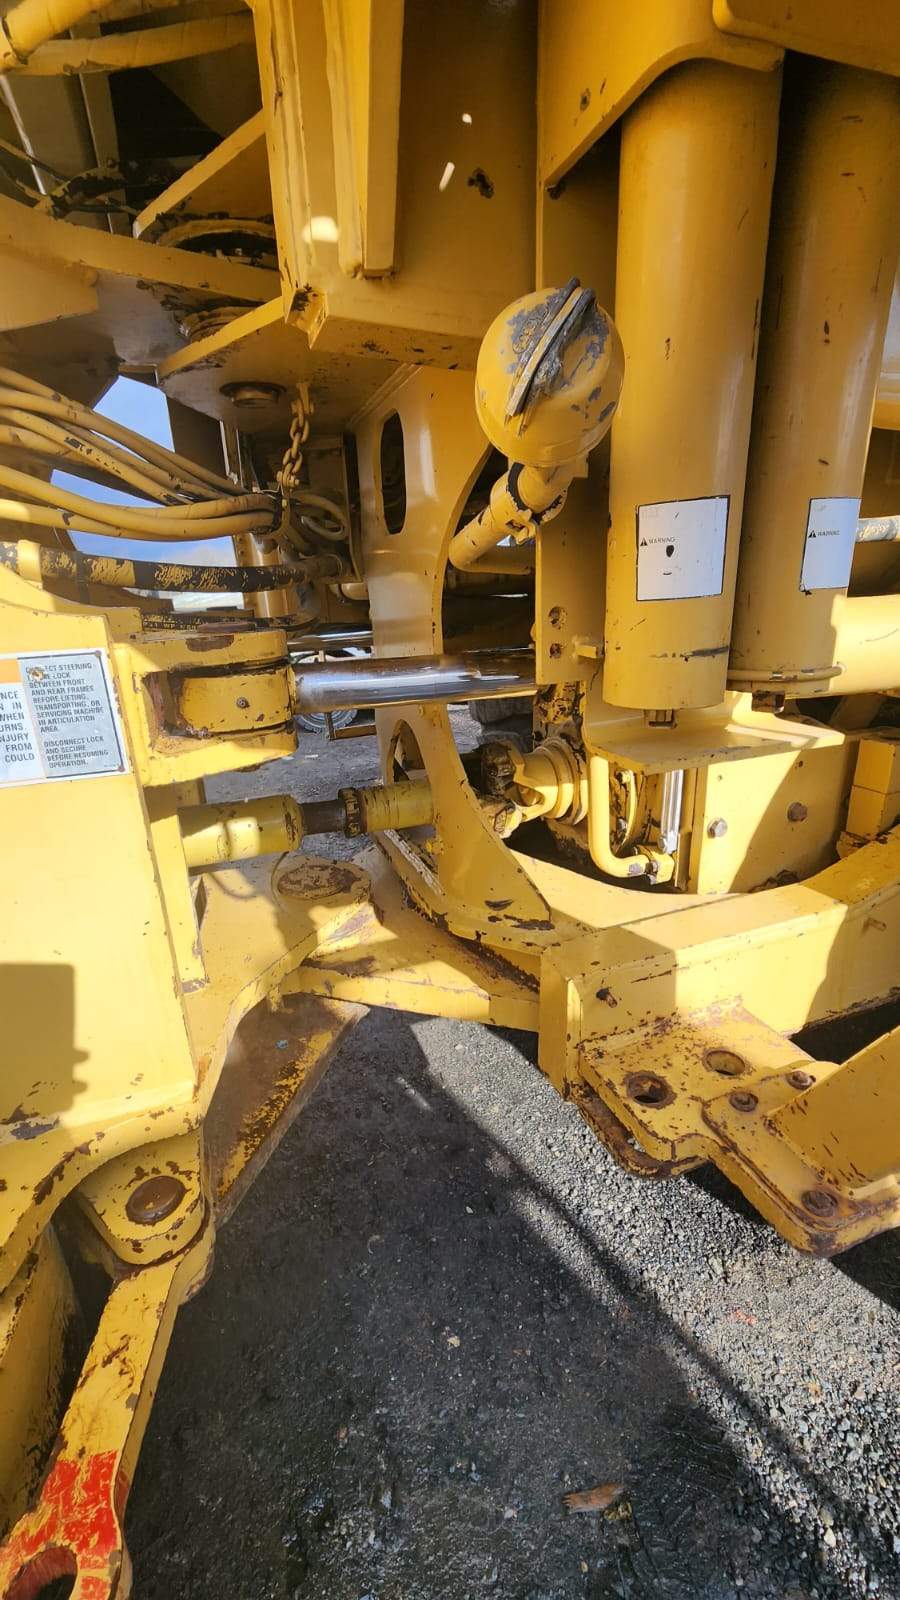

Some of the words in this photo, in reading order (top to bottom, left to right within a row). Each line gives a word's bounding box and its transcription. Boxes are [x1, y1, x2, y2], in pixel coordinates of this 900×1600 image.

[58, 662, 92, 671] STEERING
[52, 672, 71, 680] LOCK
[29, 680, 62, 689] BETWEEN
[63, 679, 86, 687] FRONT
[32, 689, 46, 697] AND
[47, 687, 65, 695] REAR
[67, 685, 95, 694] FRAMES
[33, 695, 60, 704] BEFORE
[91, 699, 101, 707] OR
[36, 708, 72, 718] SERVICING
[72, 706, 105, 715] MACHINE
[38, 718, 46, 726] IN
[47, 715, 95, 725] ARTICULATION
[43, 737, 85, 748] DISCONNECT
[86, 735, 104, 743] LOCK
[5, 742, 33, 753] FROM
[45, 747, 60, 755] AND
[60, 745, 86, 753] SECURE
[5, 752, 35, 763] COULD
[47, 753, 72, 762] BEFORE
[73, 750, 109, 759] RESUMING
